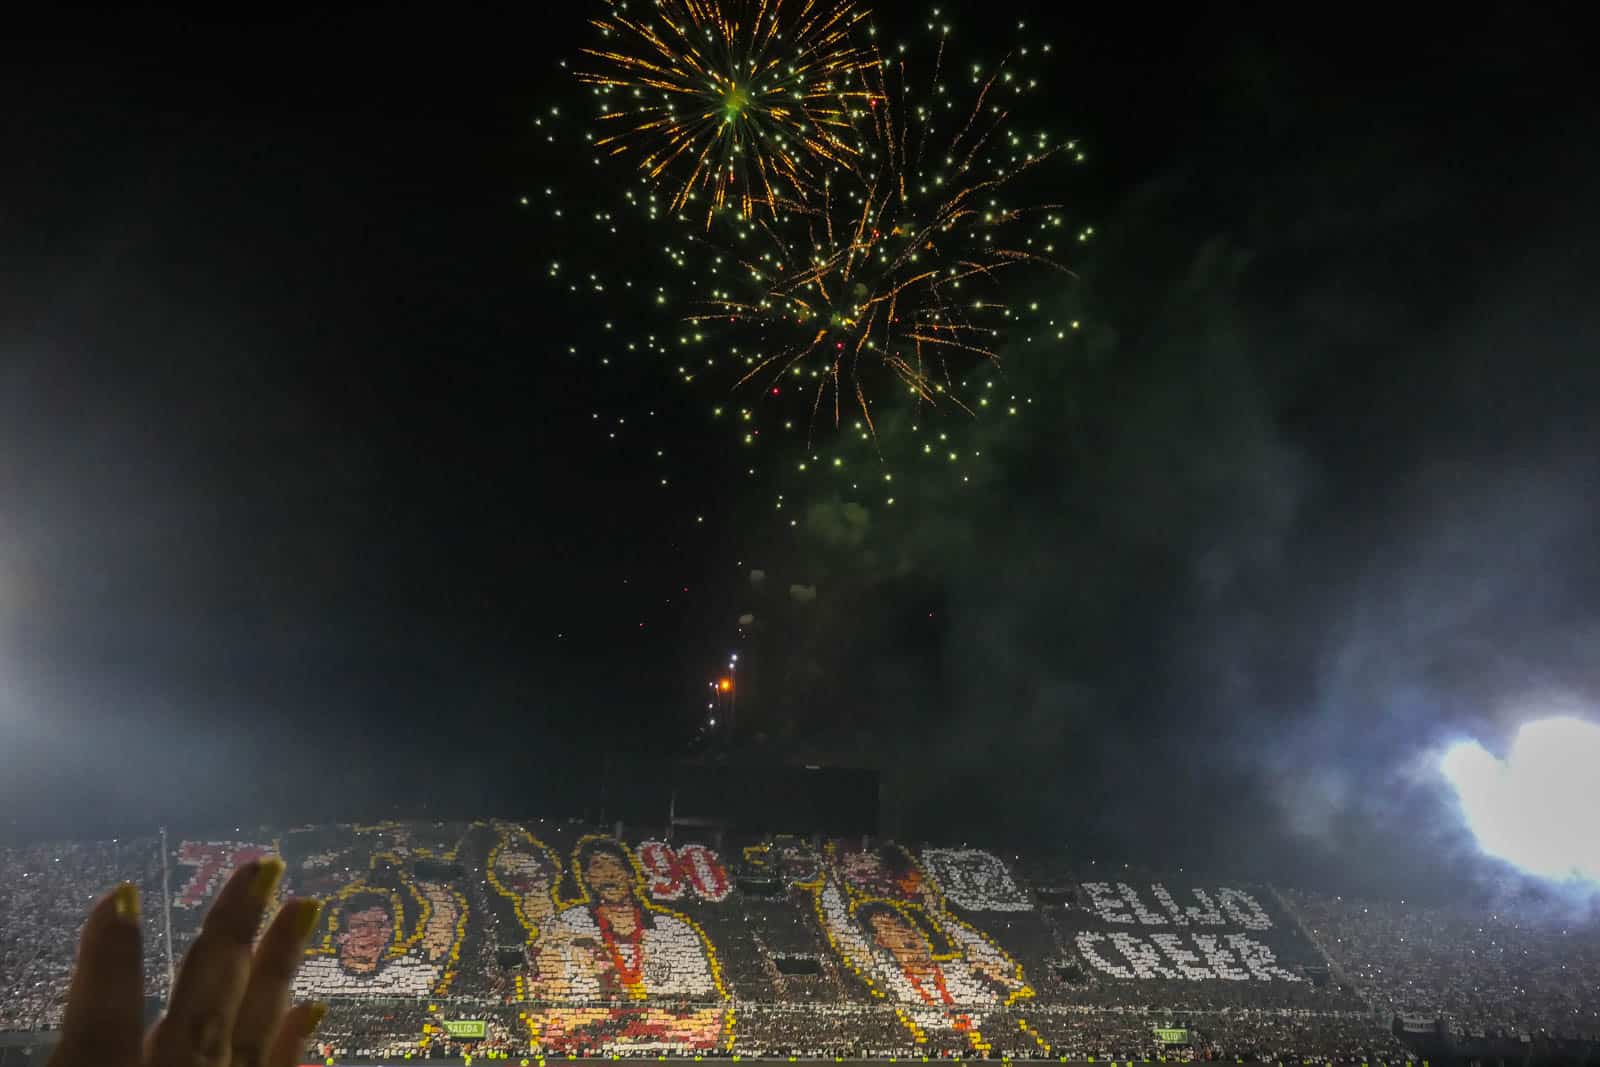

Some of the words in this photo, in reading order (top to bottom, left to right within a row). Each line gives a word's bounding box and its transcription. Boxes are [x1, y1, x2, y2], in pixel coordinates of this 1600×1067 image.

[637, 841, 733, 902] 90
[1081, 882, 1272, 930] ELIJO
[1074, 931, 1302, 981] CREER
[447, 1023, 478, 1033] SALIDA
